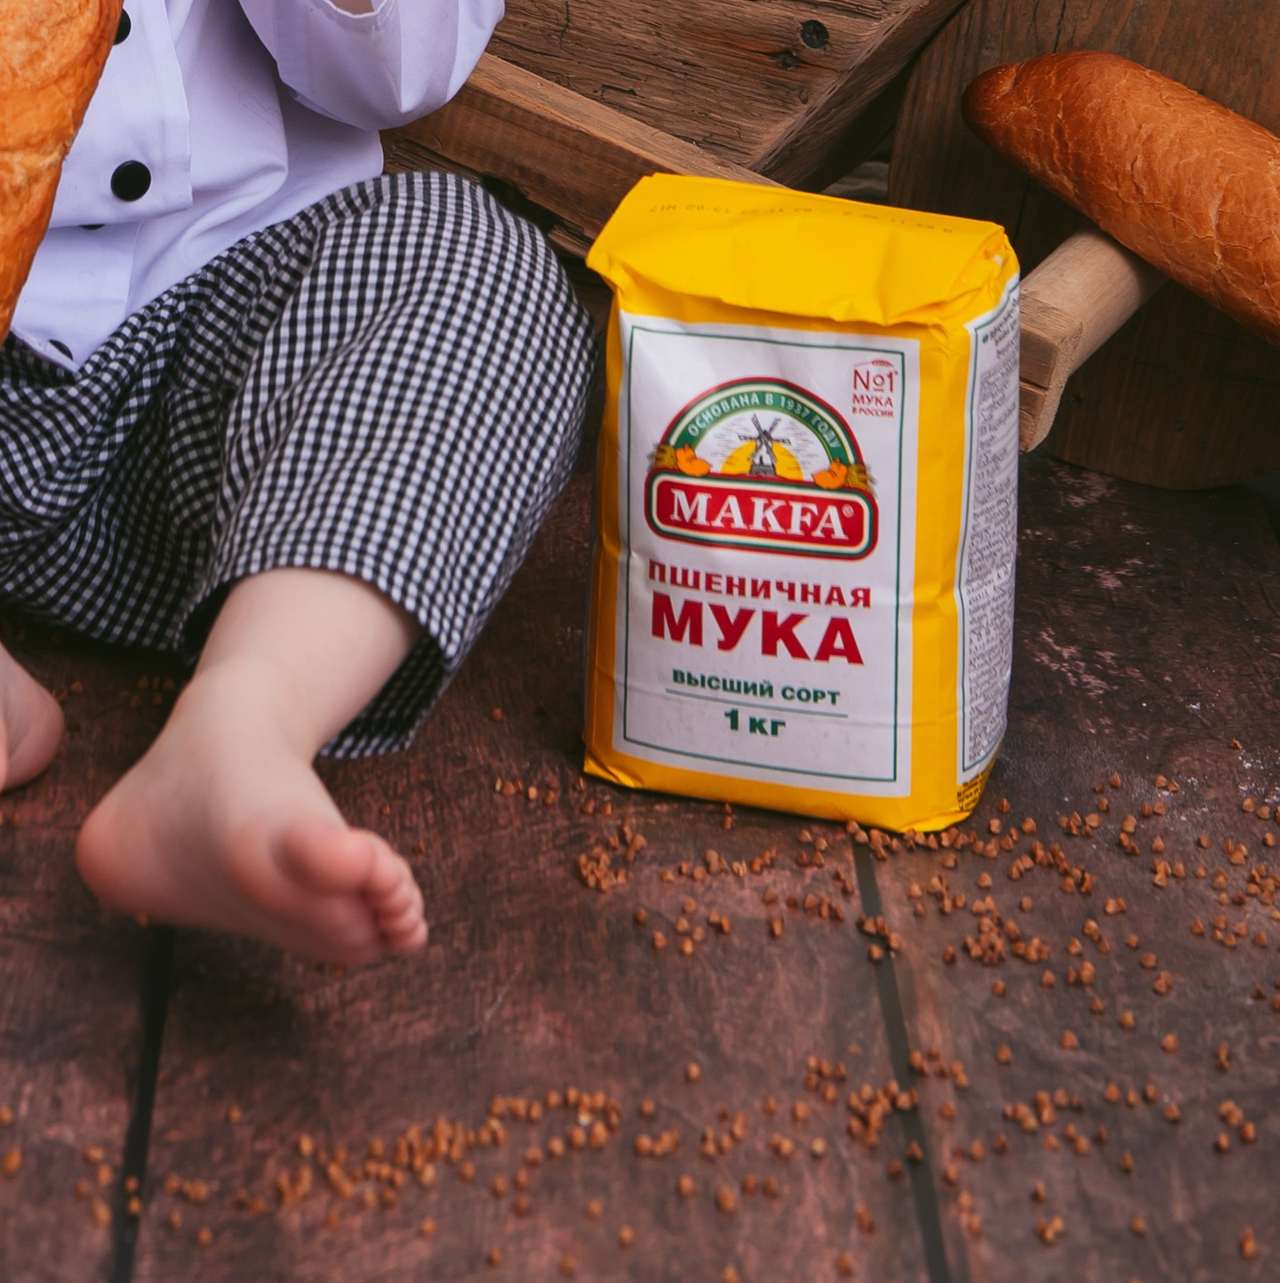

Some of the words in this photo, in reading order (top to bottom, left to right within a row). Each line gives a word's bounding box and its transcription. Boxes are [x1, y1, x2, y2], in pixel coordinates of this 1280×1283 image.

[688, 392, 760, 437] ОСНОВАНА
[765, 392, 774, 406] В
[780, 396, 810, 419] 1937
[811, 414, 842, 449] ГОДУ
[852, 393, 894, 408] МУКА
[648, 559, 871, 609] ПШЕНИЧНАЯ
[651, 591, 865, 666] МУКА
[672, 668, 773, 698] ВЫСШИЙ
[781, 685, 841, 706] СОРТ
[724, 708, 739, 731] 1
